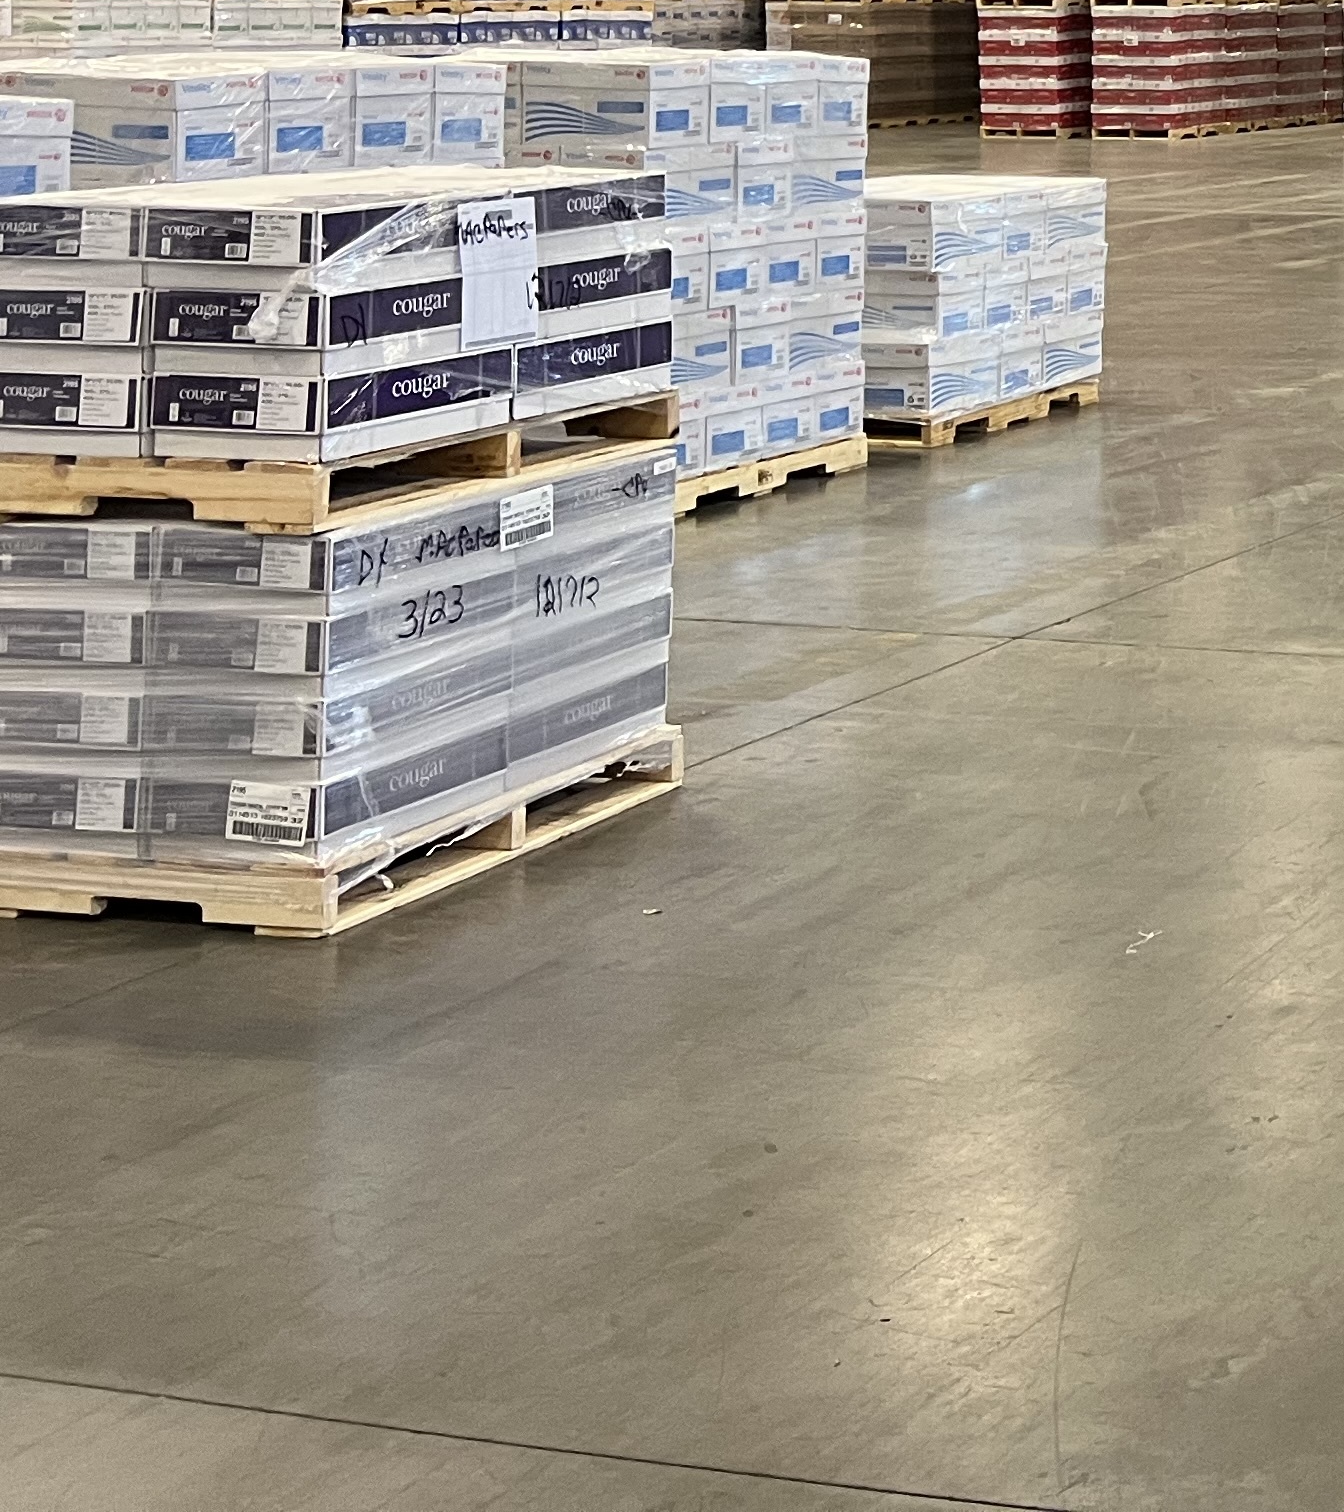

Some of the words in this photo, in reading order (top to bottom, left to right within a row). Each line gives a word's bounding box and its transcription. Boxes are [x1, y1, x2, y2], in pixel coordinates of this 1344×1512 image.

[566, 189, 613, 216] cougar
[0, 220, 40, 236] ougar
[161, 224, 209, 240] cougar
[571, 267, 621, 290] cougar
[6, 303, 54, 319] cougar
[178, 303, 229, 320] cougar
[392, 292, 451, 317] cougar
[570, 340, 620, 366] cougar
[3, 385, 50, 402] cougar
[179, 388, 228, 405] cougar
[391, 372, 451, 398] cougar
[399, 585, 465, 639] 3/23
[391, 678, 451, 711] cougar
[564, 693, 614, 725] cougar
[389, 756, 448, 792] cougar
